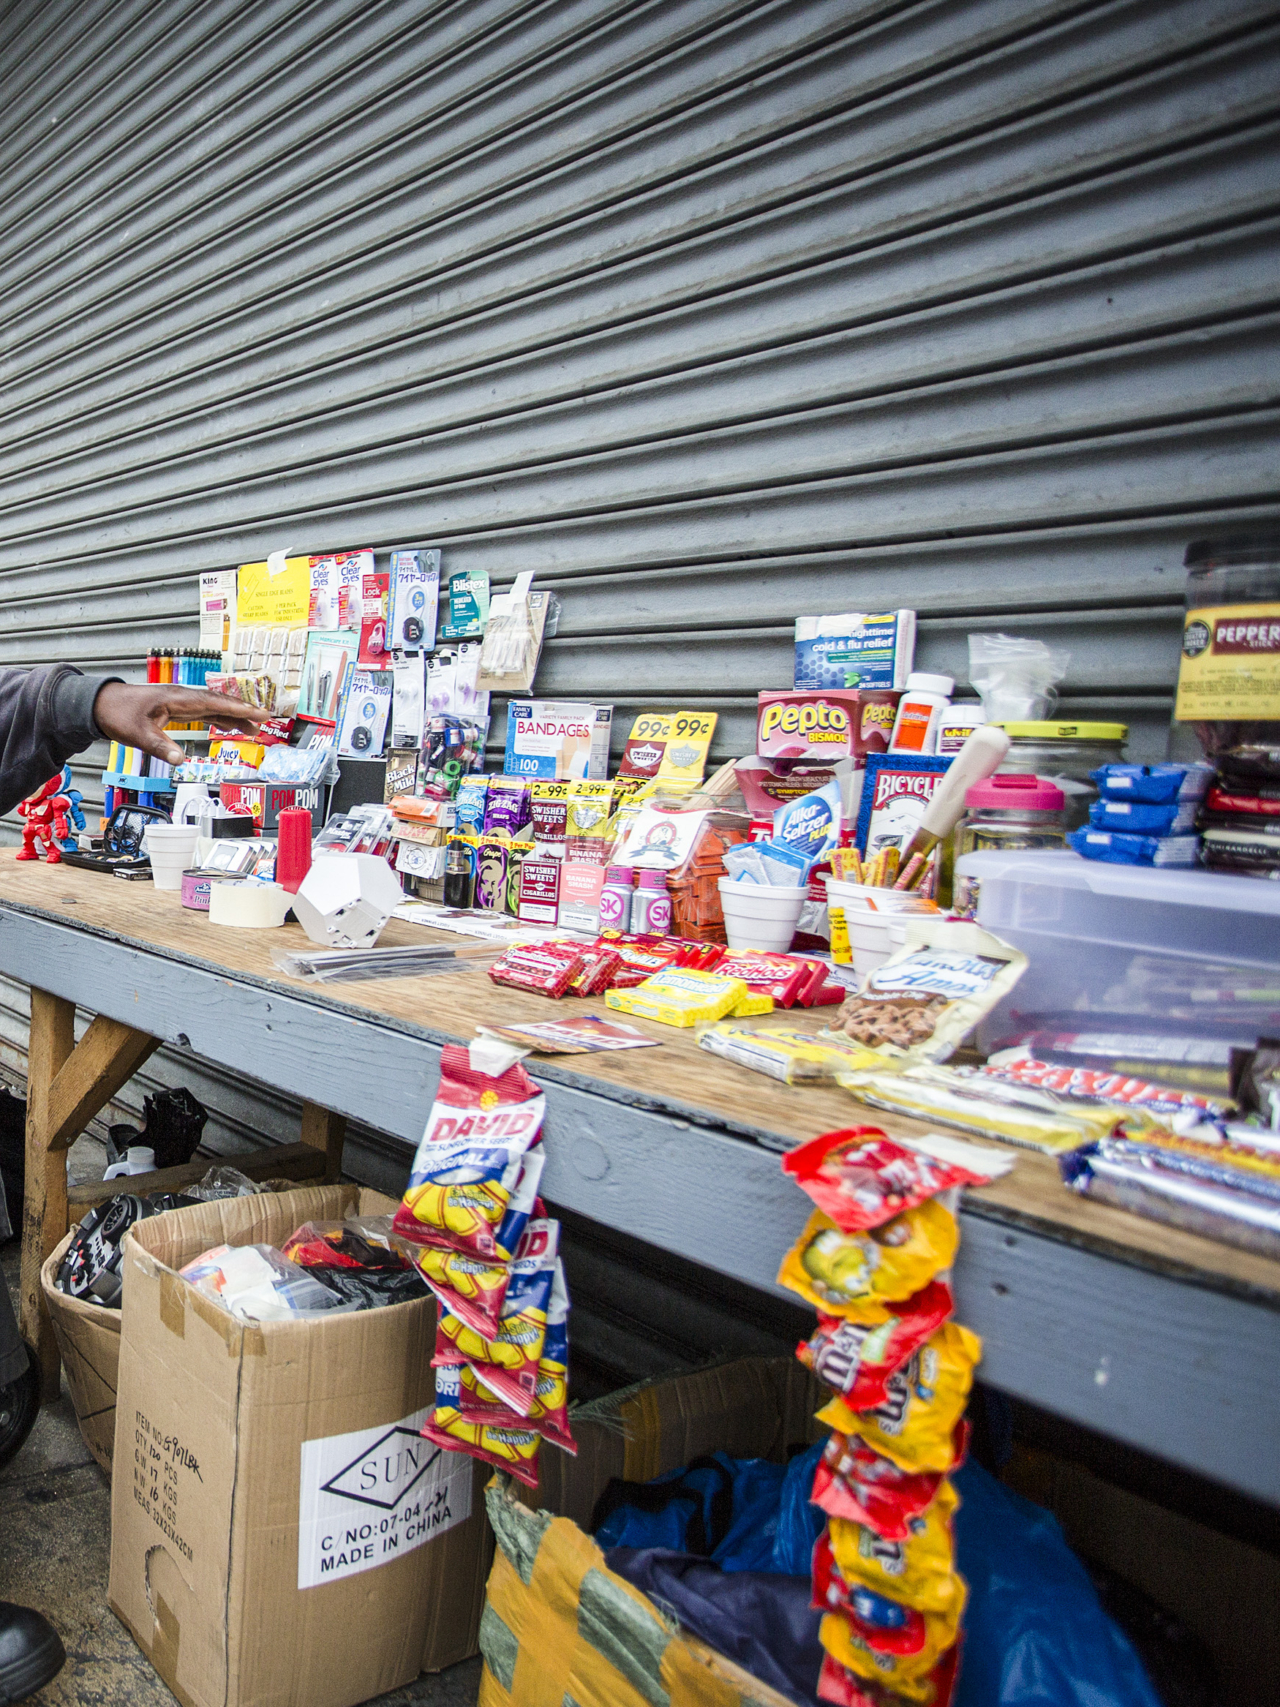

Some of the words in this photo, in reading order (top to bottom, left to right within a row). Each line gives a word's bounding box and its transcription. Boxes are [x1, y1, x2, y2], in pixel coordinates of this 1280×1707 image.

[312, 569, 329, 579] Clear
[341, 565, 361, 577] Clear
[313, 578, 329, 587] eyes
[342, 574, 360, 585] eyes
[453, 579, 486, 592] Blistex
[363, 588, 381, 596] Lock
[848, 628, 894, 639] nighttime
[1216, 625, 1280, 643] PEPPER
[812, 643, 834, 652] cold
[837, 641, 846, 650] &
[847, 639, 861, 650] flu
[863, 637, 894, 648] relief
[1248, 640, 1273, 649] STICK
[260, 723, 273, 735] Big
[273, 728, 290, 739] Red
[517, 721, 590, 738] BANDAGES
[637, 721, 671, 737] 99¢
[676, 719, 710, 737] 99¢
[945, 728, 972, 737] Advil
[808, 732, 847, 744] BISMOL
[218, 747, 239, 759] Juicy
[520, 758, 539, 772] 100
[385, 763, 416, 784] Black
[393, 776, 416, 793] Mild
[533, 785, 540, 796] 2
[547, 784, 568, 797] 99¢
[576, 784, 583, 793] 2
[588, 784, 607, 795] 99¢
[532, 806, 567, 816] SWISHER
[785, 804, 822, 829] Alka-
[533, 815, 564, 824] SWEETS
[325, 827, 352, 837] Master
[399, 827, 432, 839] RAW
[544, 825, 549, 833] 2
[783, 812, 830, 843] Seltzer
[808, 822, 832, 842] PLUS
[495, 839, 507, 847] Pack
[534, 833, 567, 841] CIGARILLOS
[483, 848, 502, 860] Grape
[569, 850, 603, 858] BANANA
[524, 866, 557, 875] SWISHER
[525, 874, 554, 883] SWEETS
[566, 875, 597, 884] BANANA
[567, 881, 593, 889] SMASH
[523, 889, 556, 898] CIGARILLOS
[652, 905, 670, 921] SK
[715, 964, 793, 979] RedHots
[654, 975, 731, 994] Lemonhead
[877, 970, 981, 994] Amos
[530, 1024, 627, 1046] DAVID
[429, 1113, 535, 1142] DAVID
[437, 1138, 488, 1152] SUNFLOWER
[488, 1136, 515, 1146] SEEDS
[421, 1152, 485, 1174] ORIGINAL
[448, 1196, 458, 1207] Be
[459, 1197, 495, 1211] Happy!
[450, 1261, 460, 1271] Be
[502, 1329, 540, 1346] Happy!
[534, 1378, 556, 1396] ppy!
[135, 1410, 150, 1434] ITEM
[486, 1431, 497, 1440] Be
[497, 1432, 535, 1446] Happy!
[149, 1444, 161, 1462] 120
[164, 1461, 178, 1486] PCS
[360, 1442, 421, 1491] SUN
[150, 1466, 158, 1482] 17
[163, 1481, 178, 1506] KGS
[149, 1486, 159, 1501] 16
[162, 1500, 177, 1526] KGS
[321, 1543, 374, 1573] MADE
[383, 1533, 398, 1552] IN
[406, 1506, 452, 1541] CHINA
